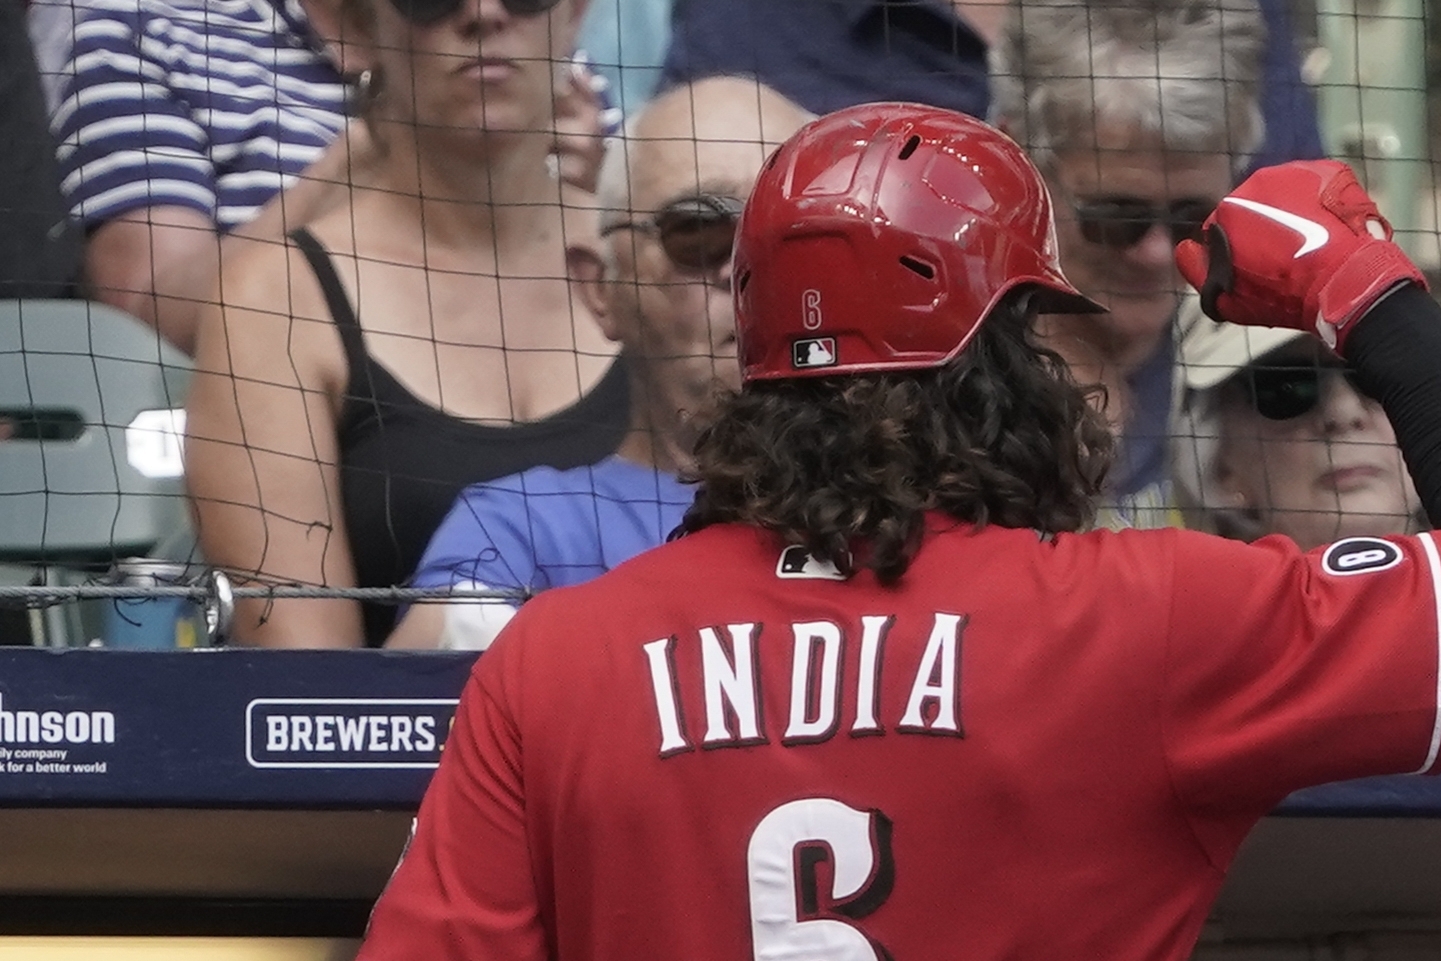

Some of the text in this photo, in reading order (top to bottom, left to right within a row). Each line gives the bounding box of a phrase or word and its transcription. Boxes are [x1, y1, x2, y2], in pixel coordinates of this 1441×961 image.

[802, 289, 822, 330] 6
[643, 612, 968, 758] INDIA
[266, 715, 455, 751] BREWERS.
[7, 761, 25, 773] for
[35, 761, 71, 773] better
[73, 761, 107, 773] world
[14, 749, 68, 761] company
